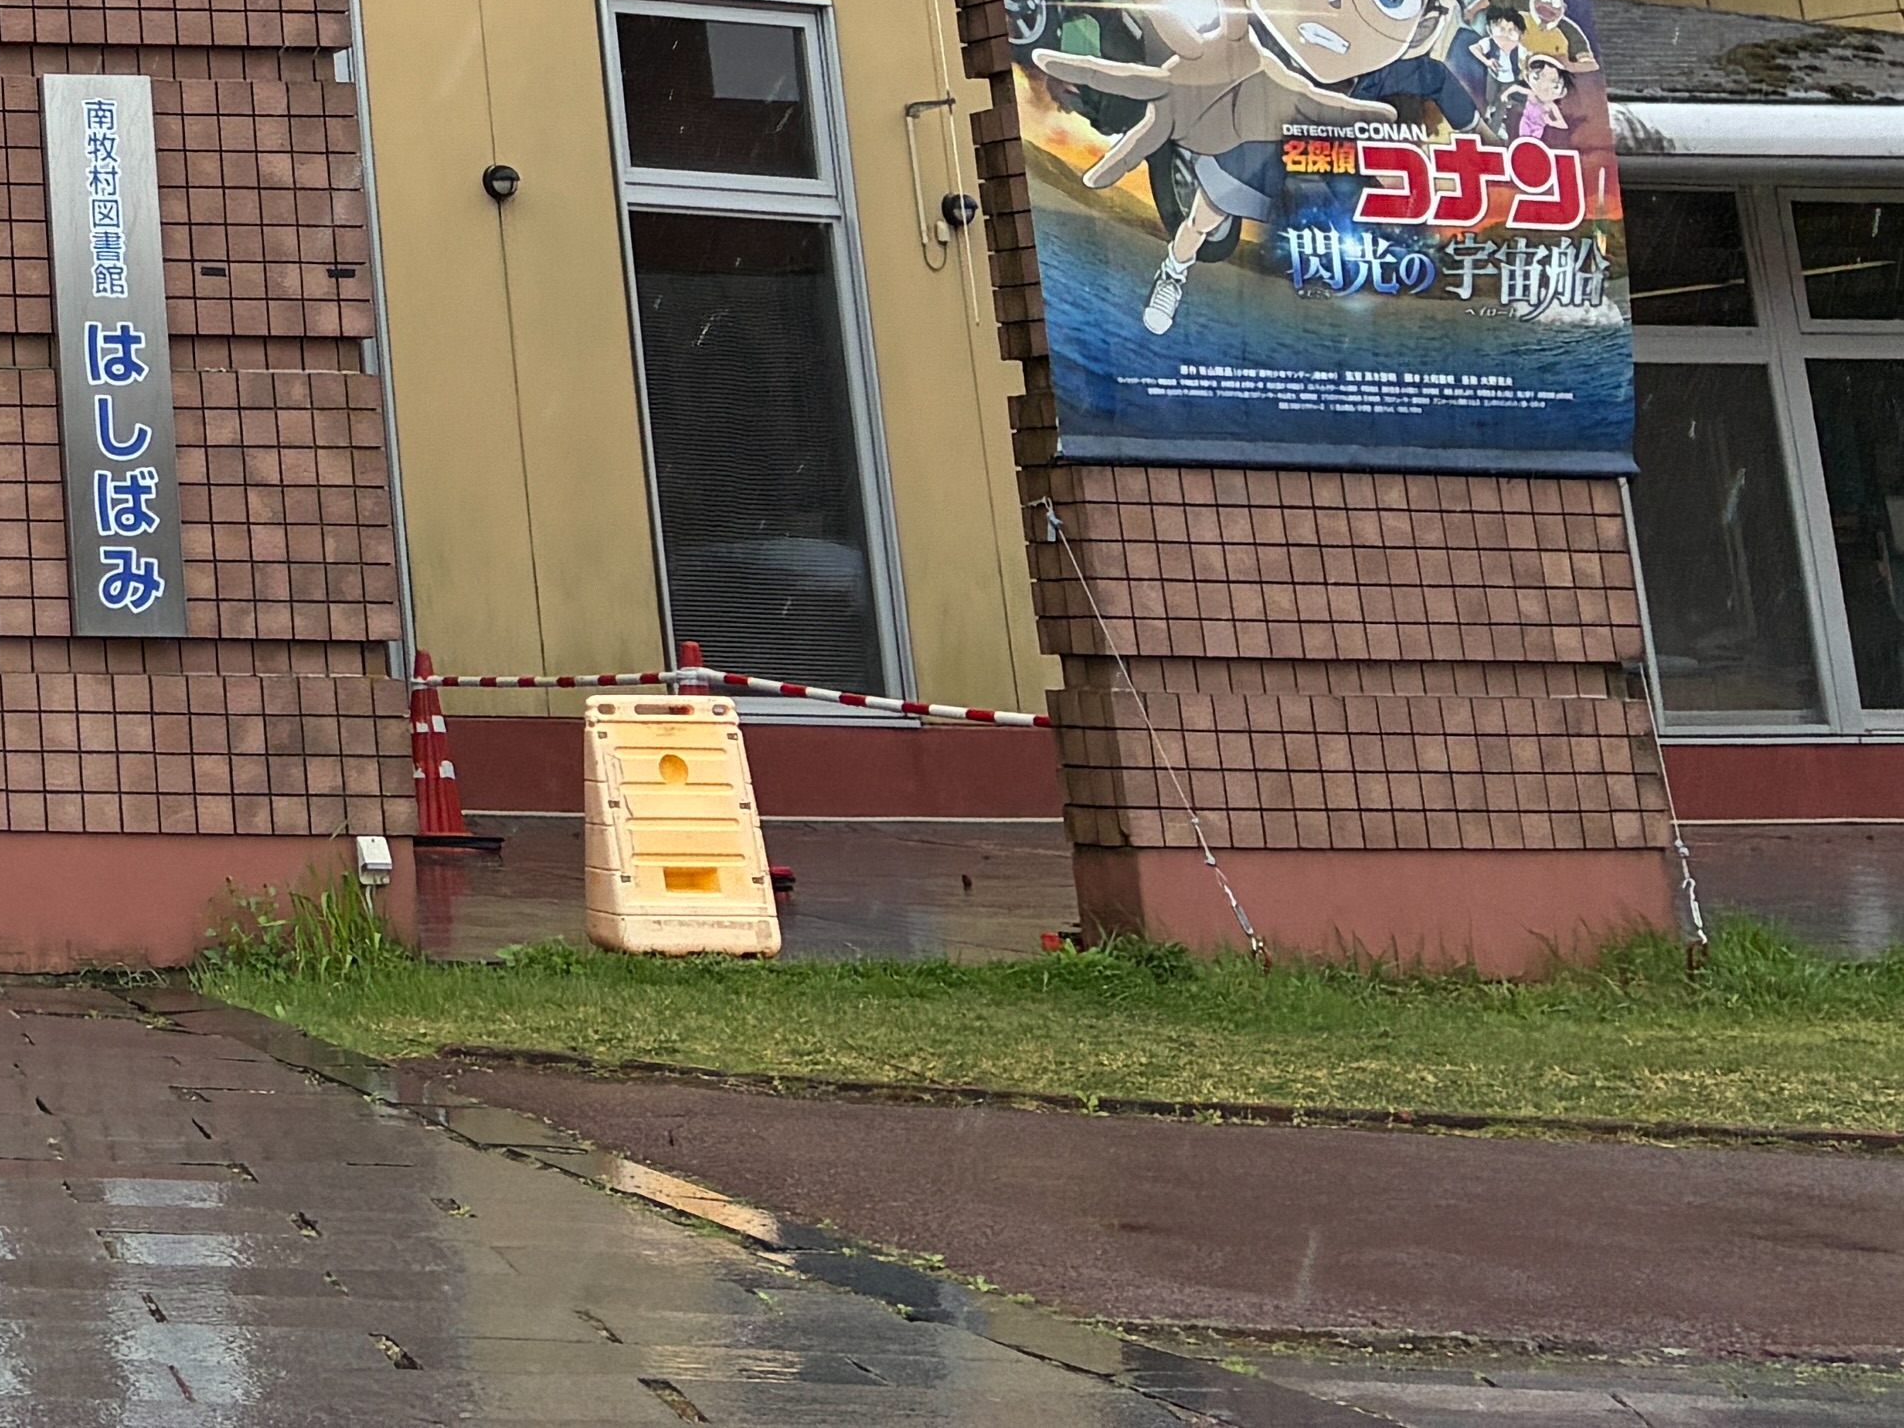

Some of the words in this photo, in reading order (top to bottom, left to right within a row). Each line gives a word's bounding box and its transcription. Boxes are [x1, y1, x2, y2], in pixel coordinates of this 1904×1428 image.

[82, 97, 128, 299] 南牧村図書館
[1282, 123, 1355, 139] DETECTIVE
[1354, 121, 1429, 142] CONAN
[1282, 139, 1357, 175] 名探偵
[1353, 133, 1587, 231] コナン
[84, 320, 166, 615] はしばみ
